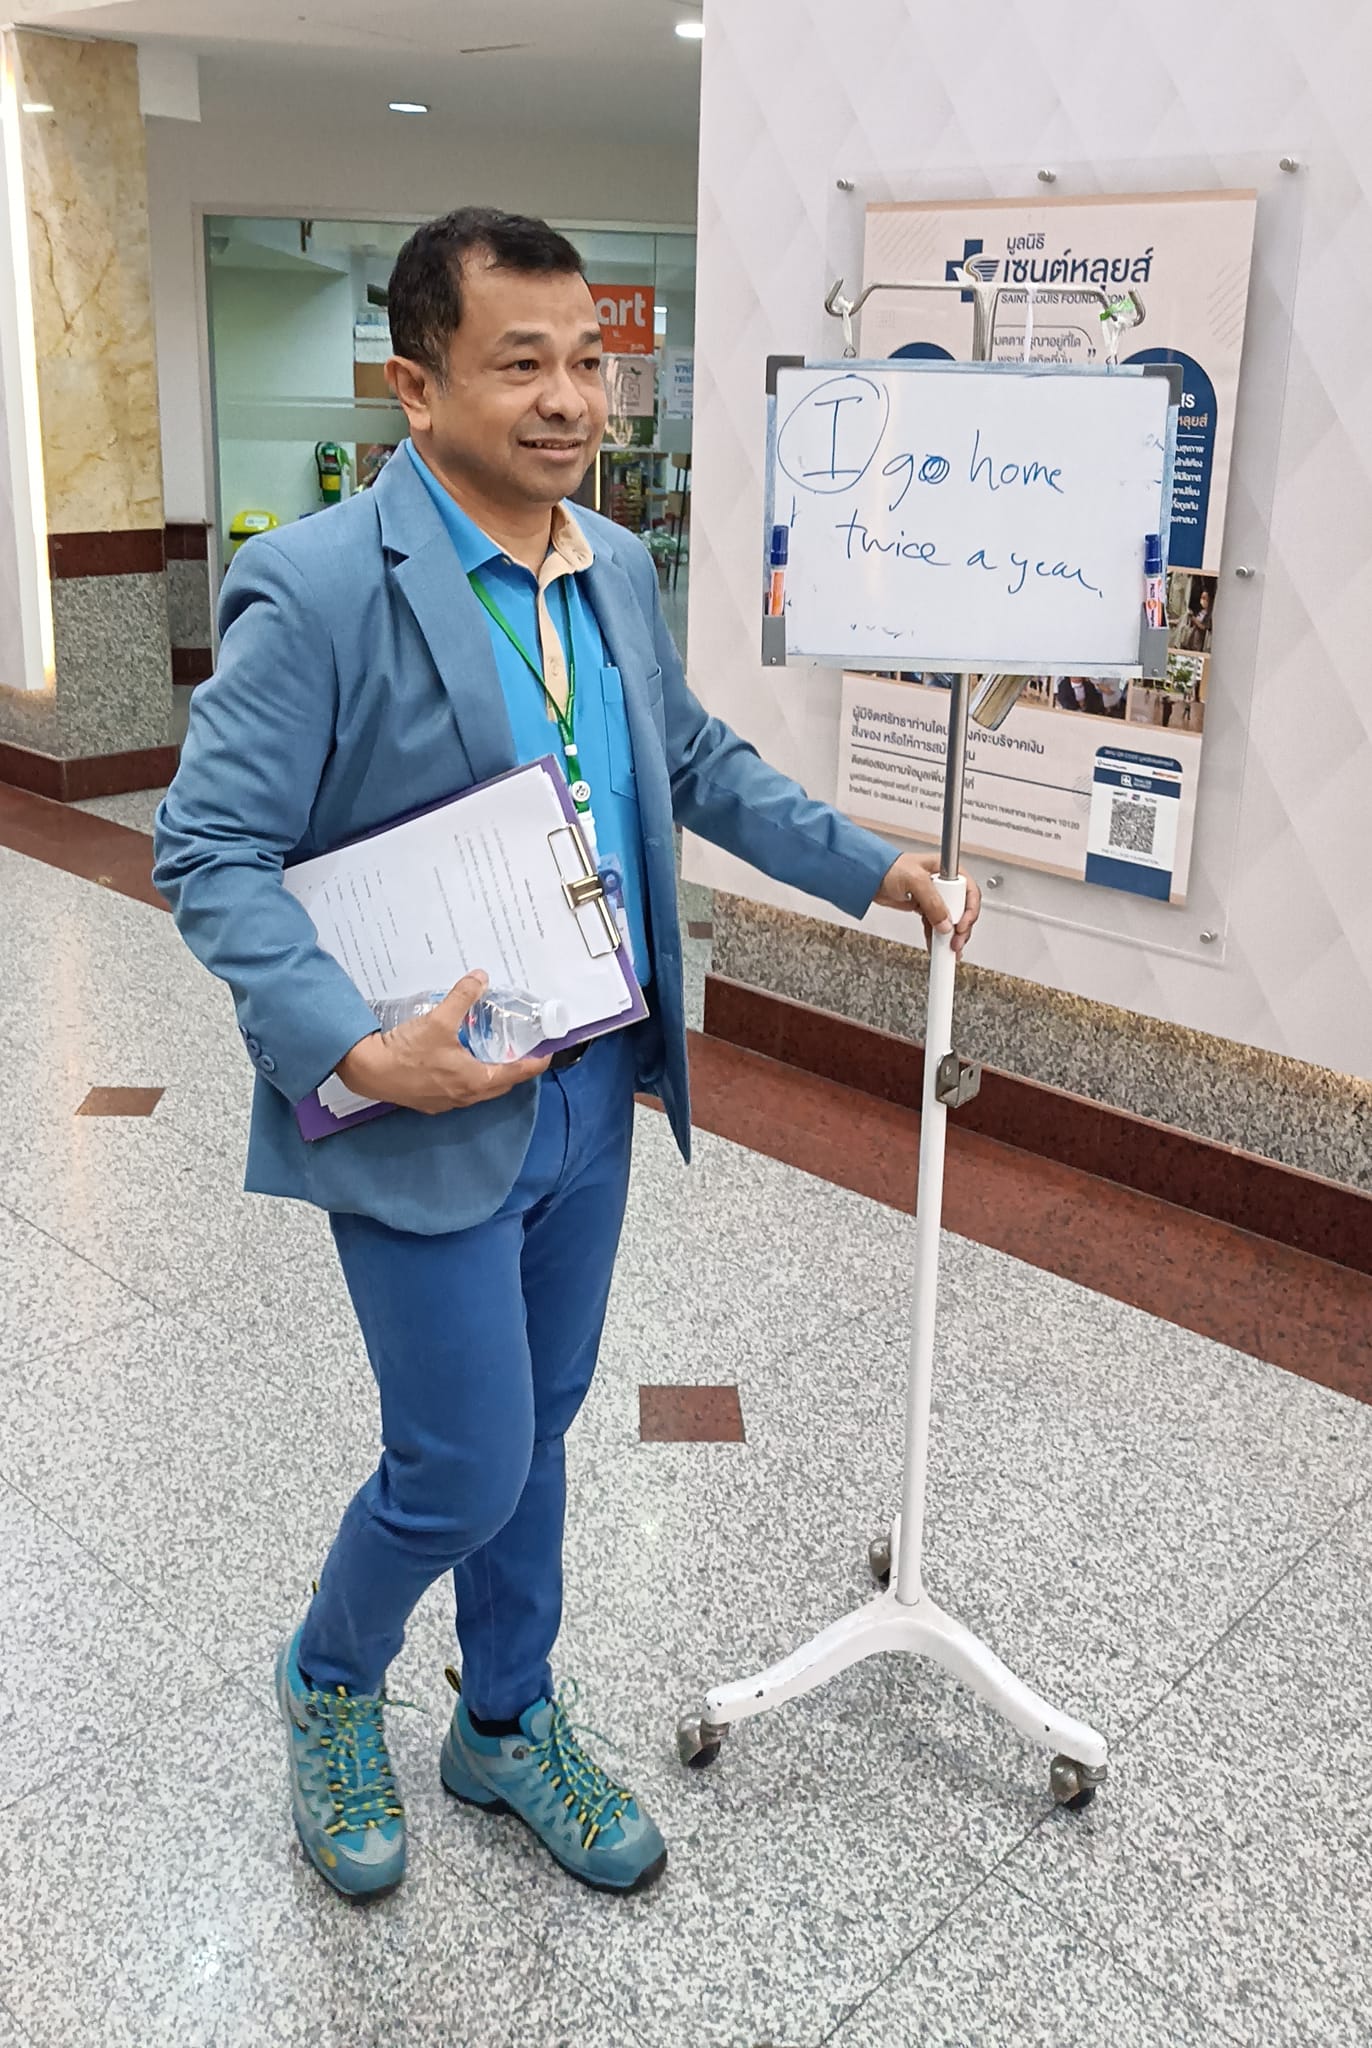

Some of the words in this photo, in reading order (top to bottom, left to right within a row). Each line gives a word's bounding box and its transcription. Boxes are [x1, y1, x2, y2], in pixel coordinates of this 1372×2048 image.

[1006, 232, 1046, 255] มูลนิธิ
[1003, 247, 1154, 292] เซนต์หลุยส์
[1030, 294, 1060, 305] OUIS
[1061, 294, 1126, 305] FOUNDION
[802, 396, 864, 480] I
[882, 453, 951, 512] go
[969, 429, 1065, 494] home
[836, 508, 952, 560] twice
[966, 549, 999, 570] a
